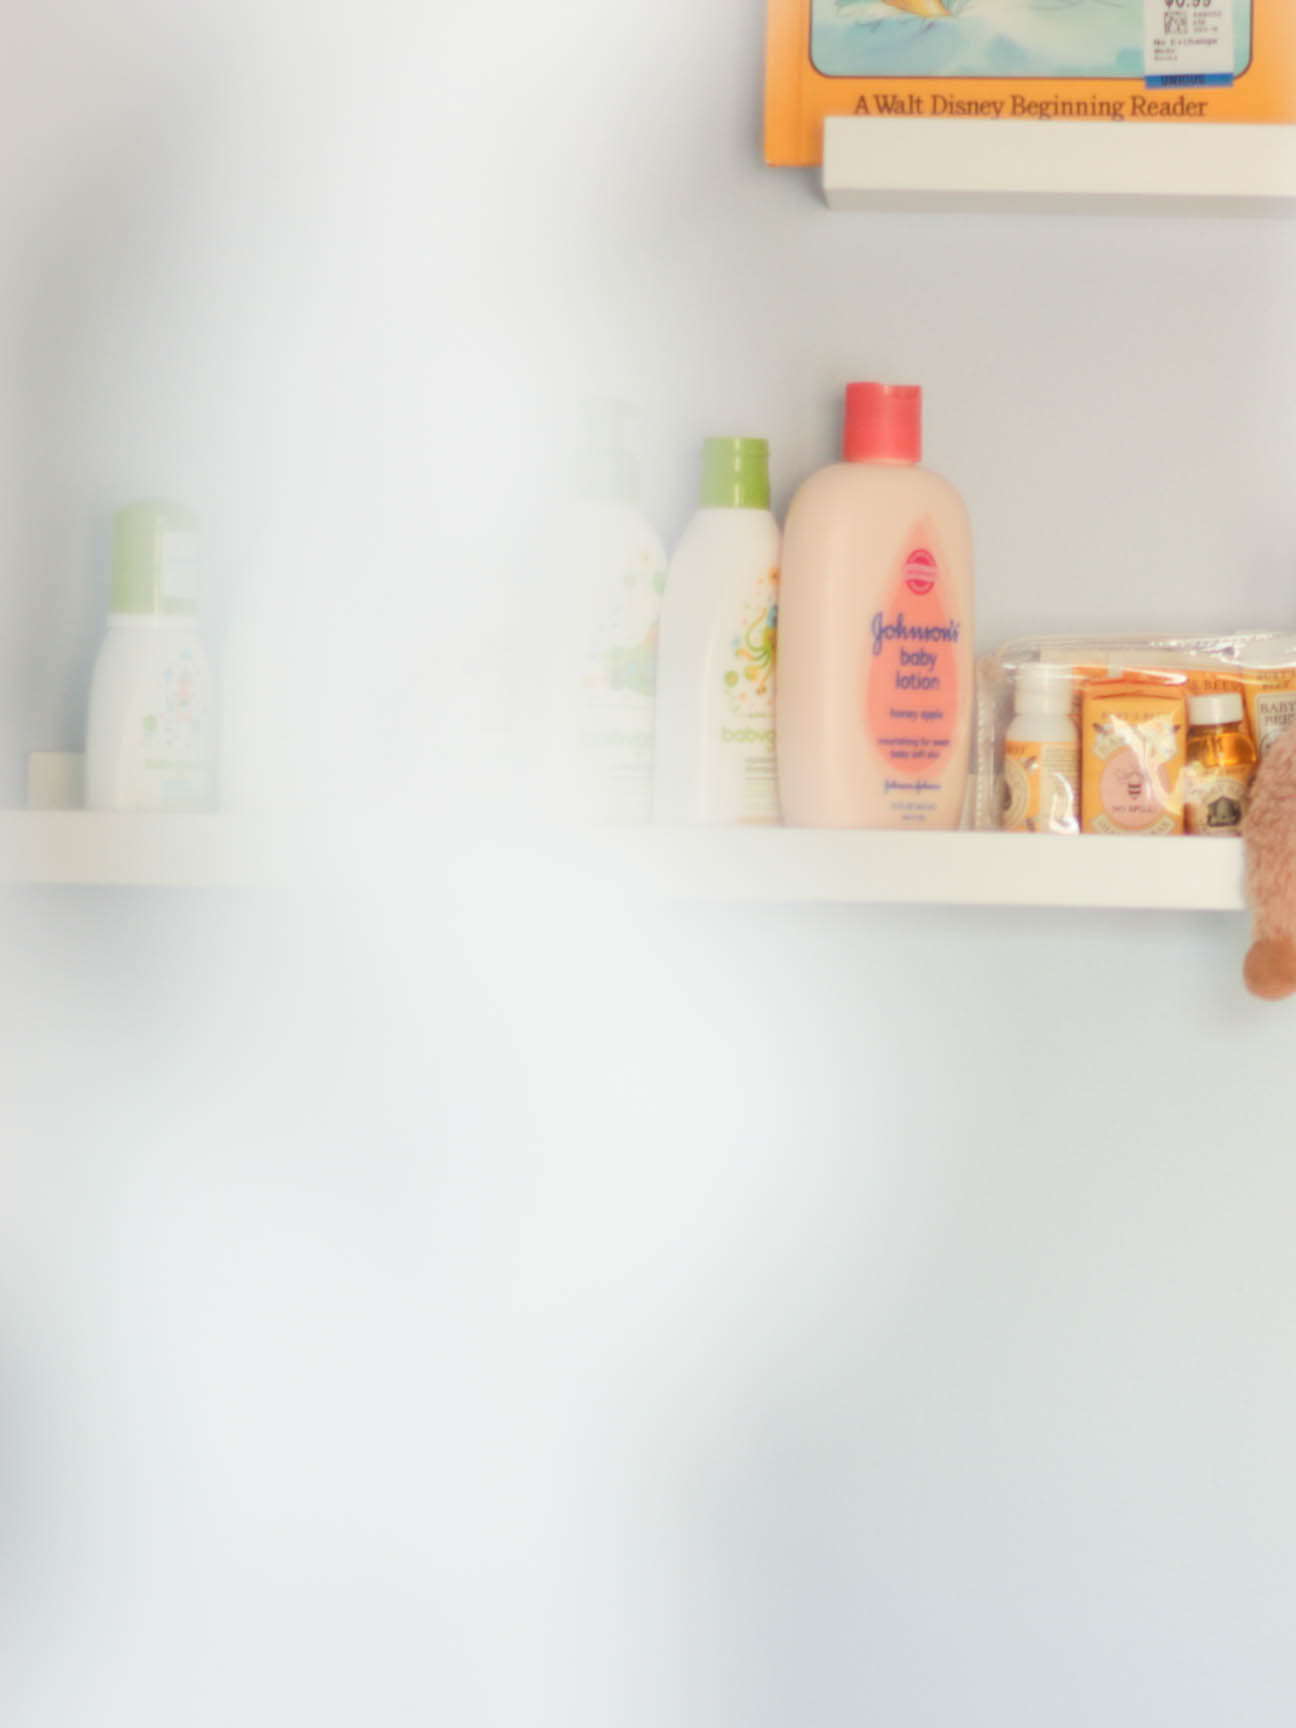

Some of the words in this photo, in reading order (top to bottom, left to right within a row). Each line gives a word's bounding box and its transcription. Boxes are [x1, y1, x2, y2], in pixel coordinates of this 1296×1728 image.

[854, 94, 870, 116] A
[873, 93, 924, 116] Walt
[931, 94, 1005, 120] Disney
[1010, 93, 1125, 121] Beginning
[1131, 95, 1208, 118] Reader
[871, 611, 960, 657] Johnson's
[899, 648, 937, 673] baby
[895, 669, 940, 690] lotion
[1260, 700, 1296, 714] BABY
